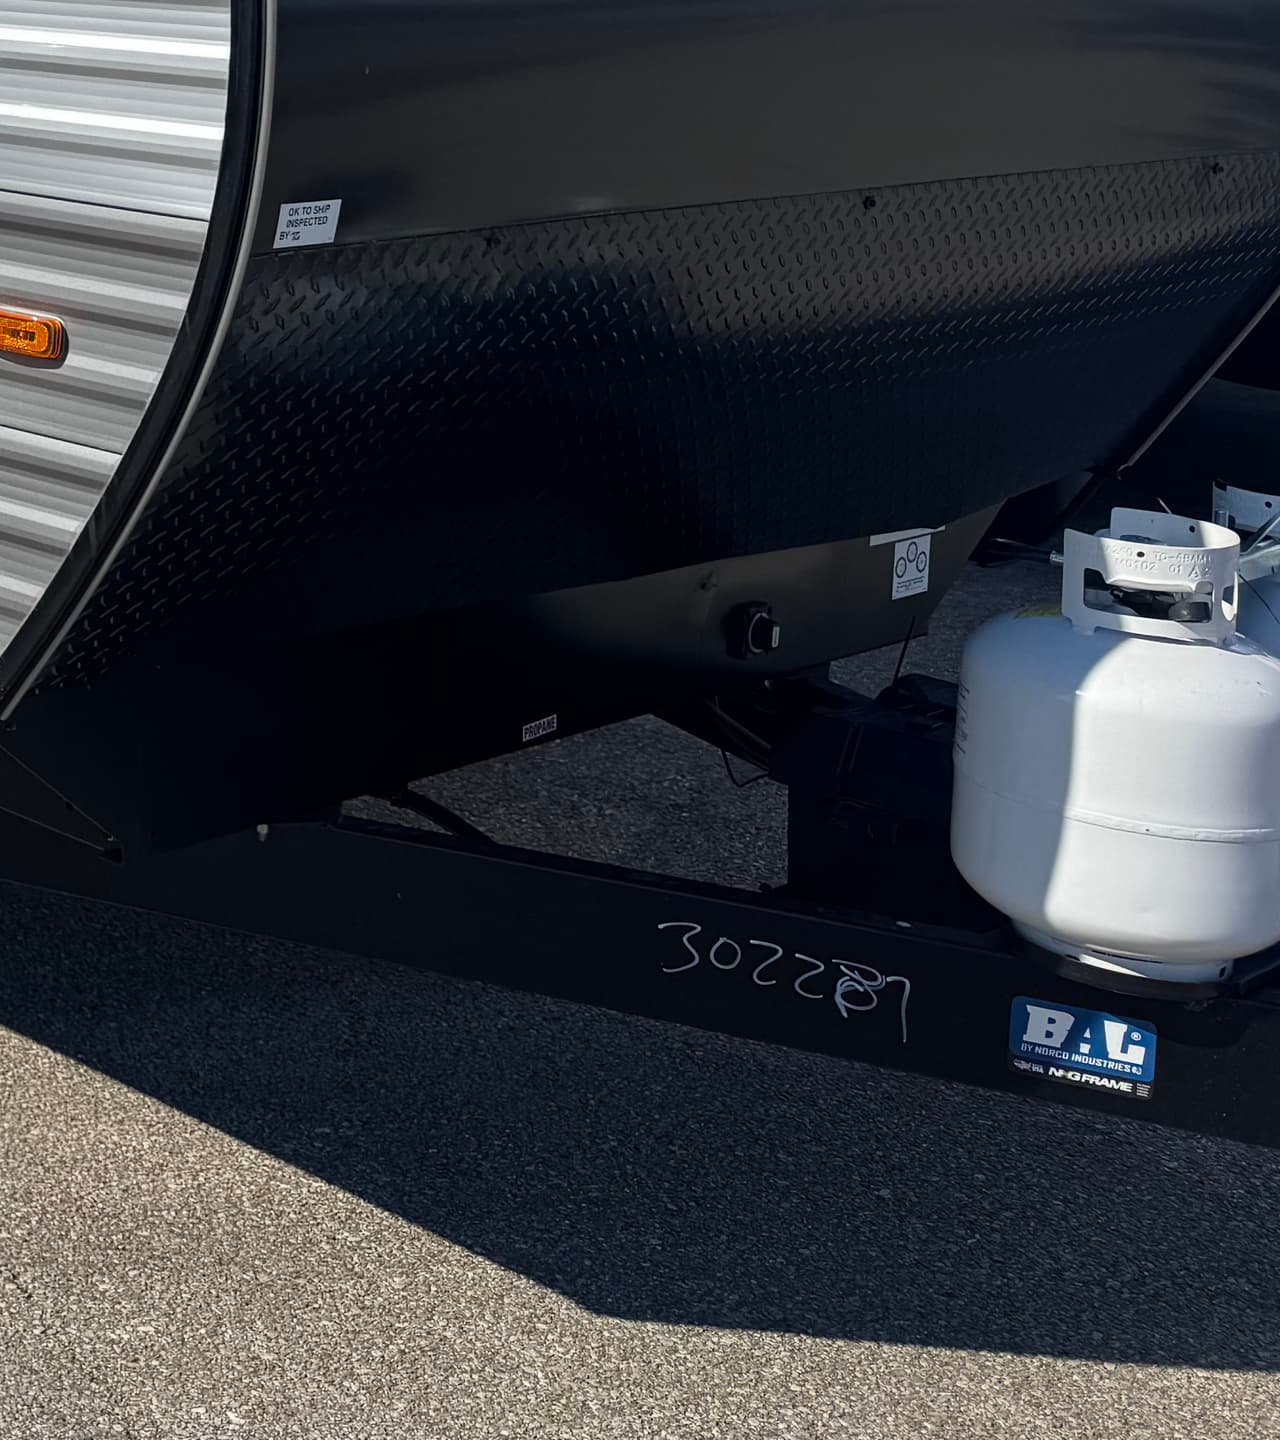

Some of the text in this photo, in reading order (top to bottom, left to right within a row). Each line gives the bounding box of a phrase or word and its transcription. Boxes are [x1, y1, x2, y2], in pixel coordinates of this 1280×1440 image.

[288, 204, 331, 216] OK TO SHIP
[286, 216, 328, 228] INSPECTED
[1020, 1042, 1132, 1073] BY NORCO INDUSTRIES
[1081, 1071, 1134, 1093] FRAME
